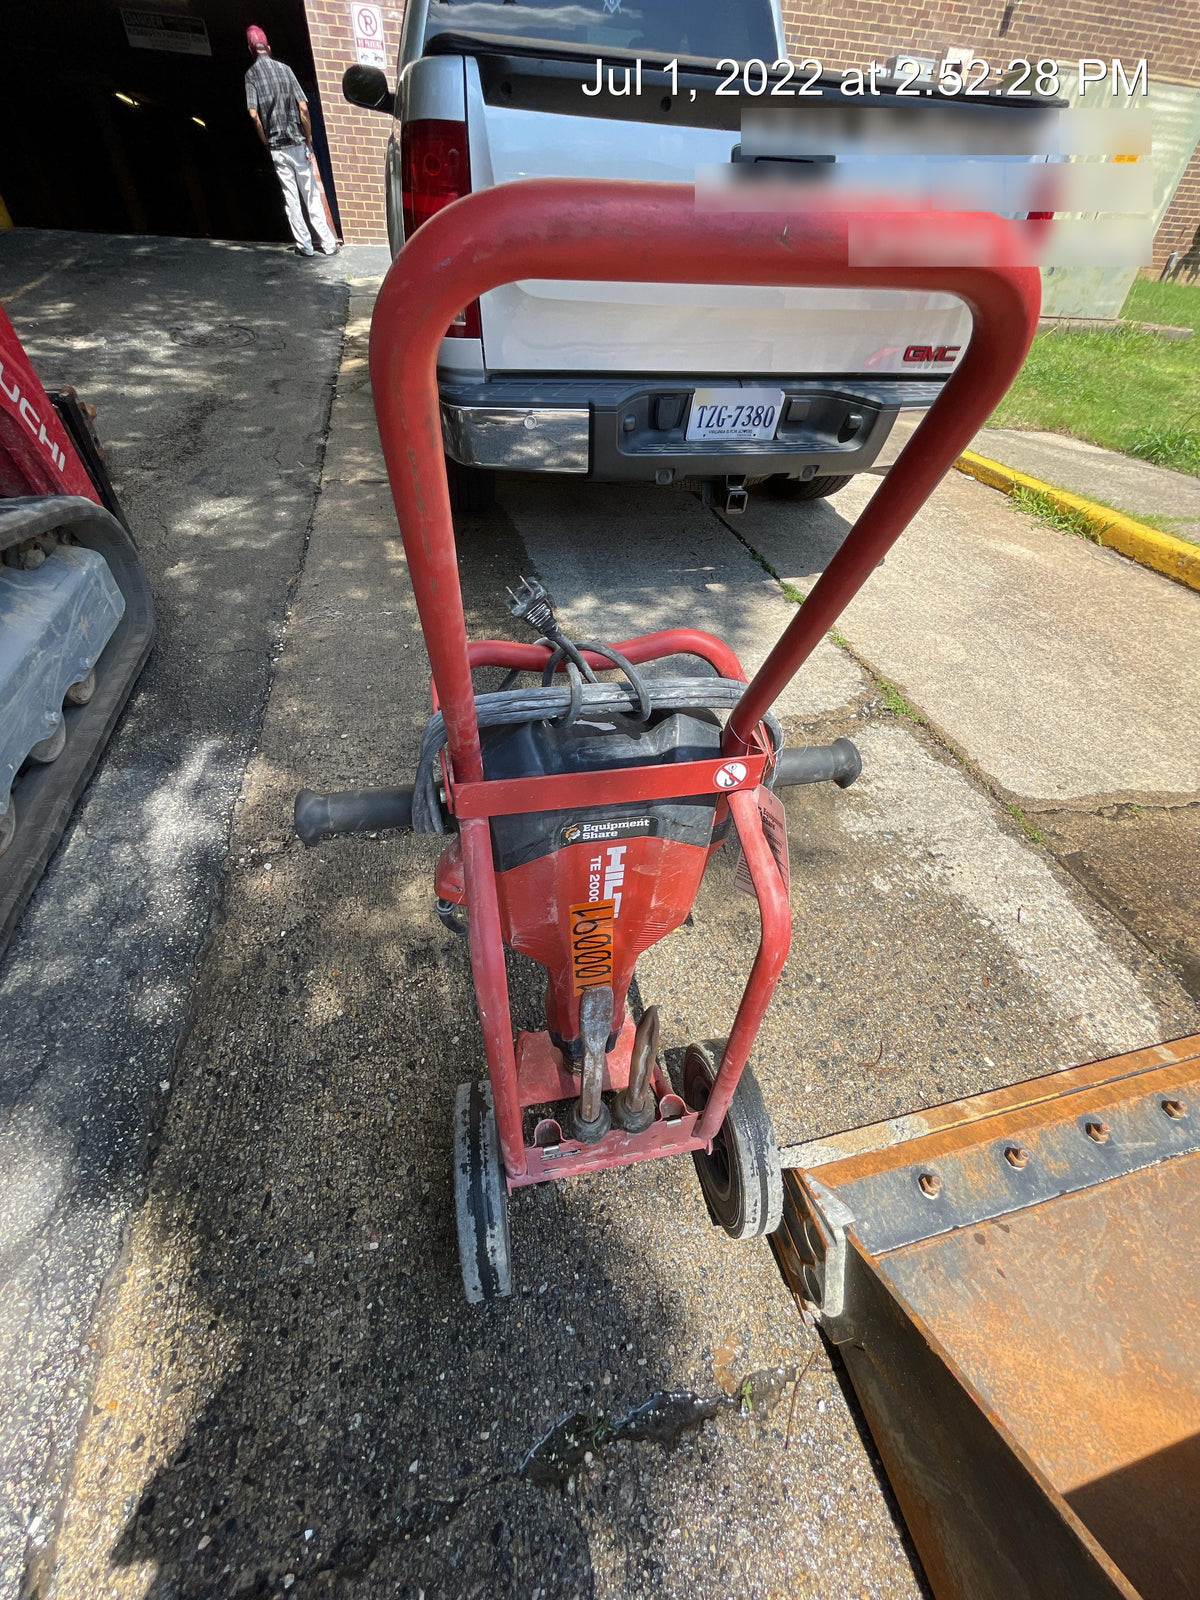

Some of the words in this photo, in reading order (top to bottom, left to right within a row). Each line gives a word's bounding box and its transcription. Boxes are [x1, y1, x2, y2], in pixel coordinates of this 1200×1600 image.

[903, 345, 961, 362] GMC
[696, 405, 776, 429] TZG-7380
[583, 818, 650, 833] Equipment
[582, 829, 619, 840] Share
[590, 855, 602, 872] TE
[588, 873, 601, 903] 2000
[603, 845, 627, 919] HILT
